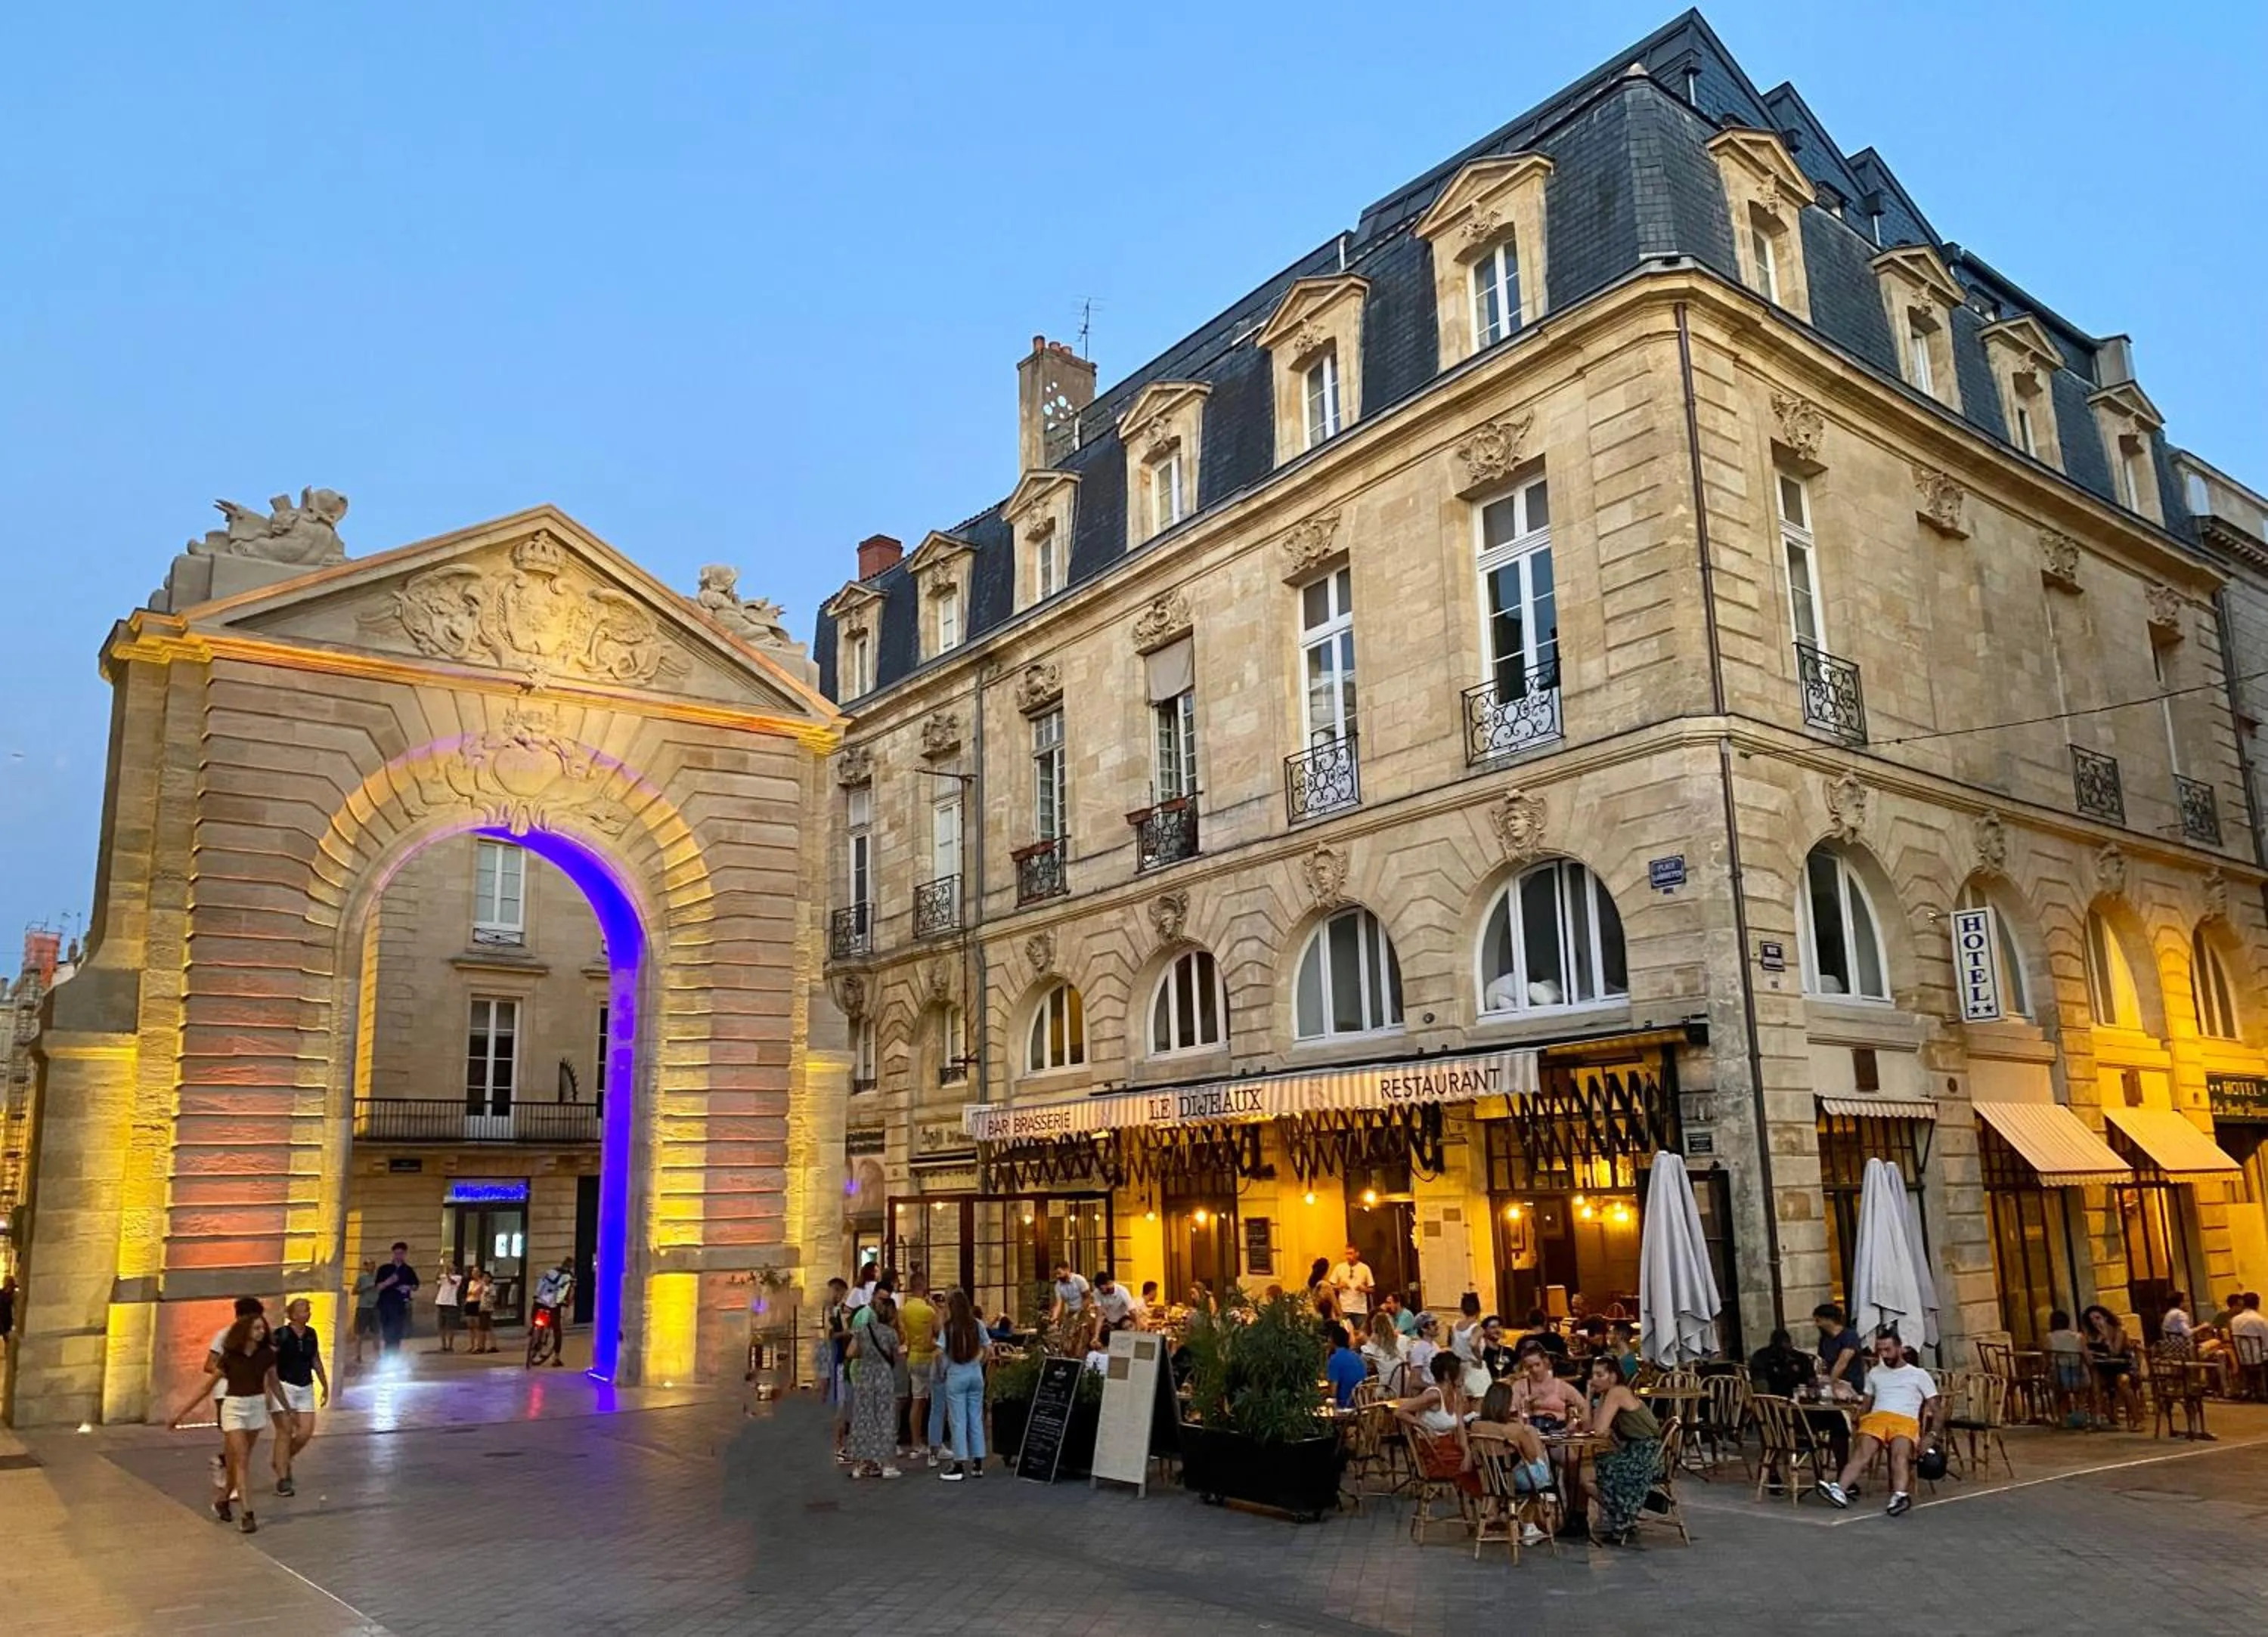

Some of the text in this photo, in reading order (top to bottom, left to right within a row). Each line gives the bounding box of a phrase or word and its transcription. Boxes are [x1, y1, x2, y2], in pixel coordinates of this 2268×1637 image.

[1962, 917, 1991, 1002] HOTEL
[1380, 1068, 1501, 1099] RESTAURANT
[2223, 1081, 2261, 1097] HOTEL
[1148, 1088, 1263, 1121] LE DIJEAUX
[987, 1112, 1071, 1135] BAR BRASSERIE
